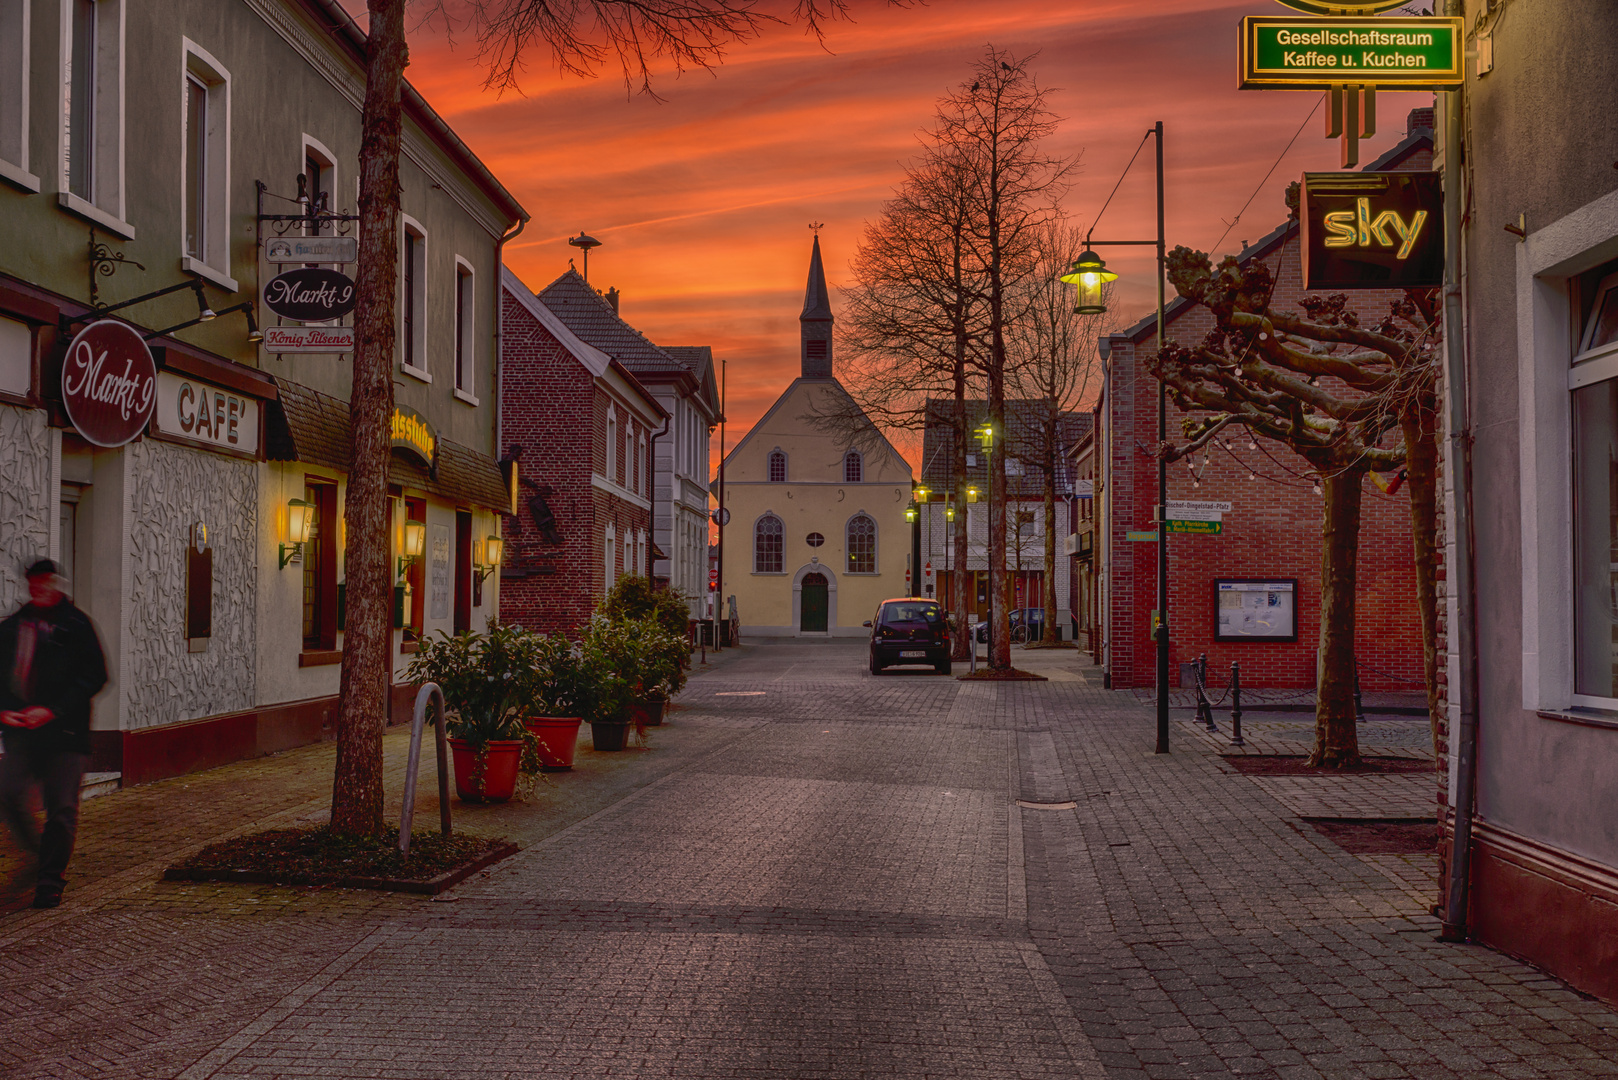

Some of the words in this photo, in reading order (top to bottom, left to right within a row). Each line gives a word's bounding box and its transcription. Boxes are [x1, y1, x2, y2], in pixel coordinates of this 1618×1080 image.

[1277, 30, 1433, 46] Gesellschaftsraum
[1284, 52, 1337, 67] Kaffee
[1342, 55, 1357, 67] u.
[1363, 52, 1426, 67] Kuchen
[1324, 197, 1428, 260] sky
[266, 279, 337, 309] Markt
[337, 285, 353, 304] 9
[267, 330, 353, 347] König-Pilsener
[65, 341, 140, 421] Markt
[135, 376, 154, 414] 9
